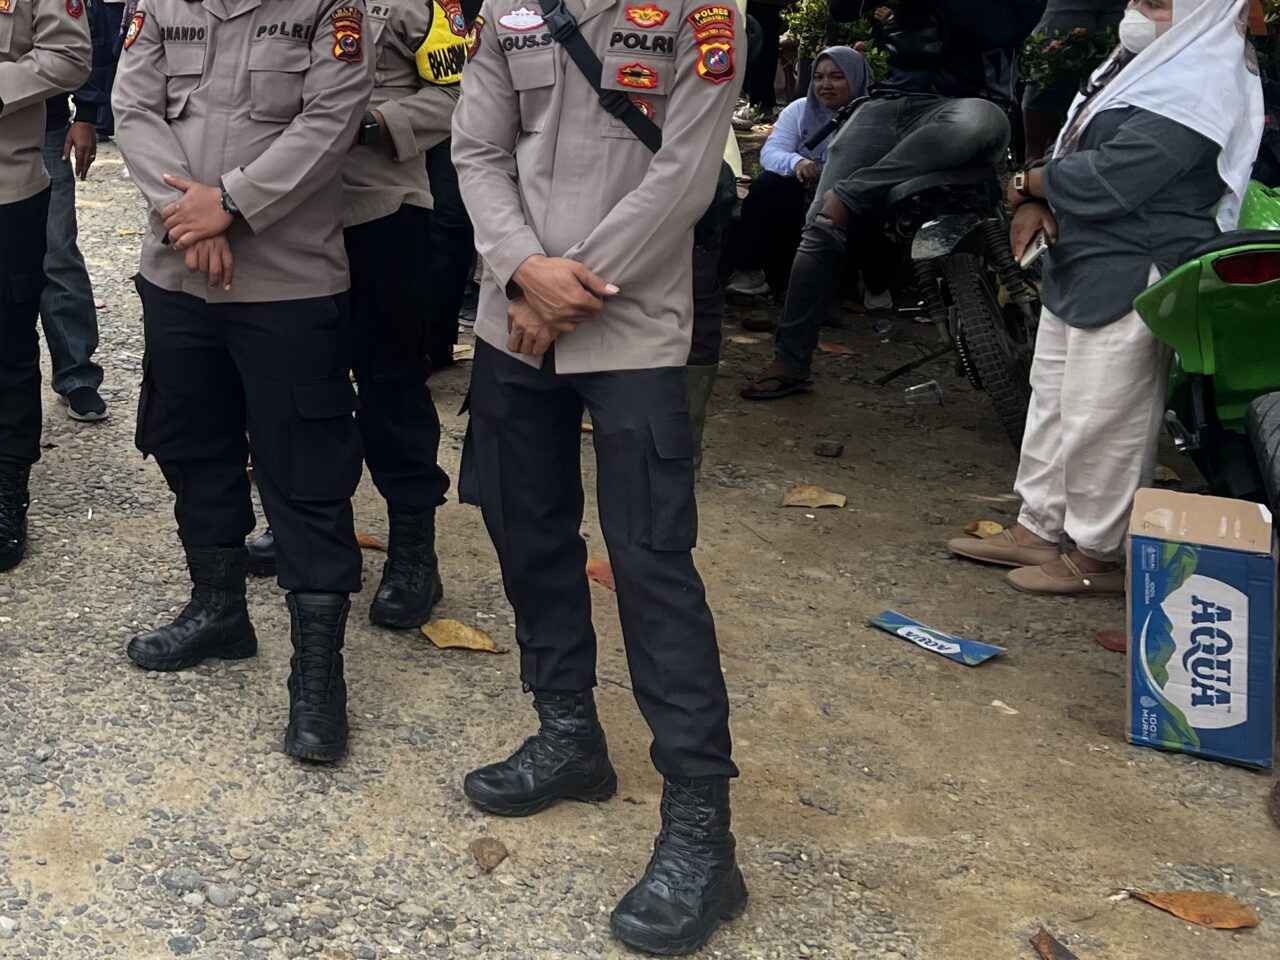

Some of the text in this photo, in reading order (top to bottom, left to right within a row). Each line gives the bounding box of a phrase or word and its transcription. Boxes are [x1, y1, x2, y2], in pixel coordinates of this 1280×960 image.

[694, 7, 729, 20] POLRES
[256, 21, 311, 40] POLRI
[609, 31, 673, 53] POLRI
[1182, 595, 1233, 707] AQUA
